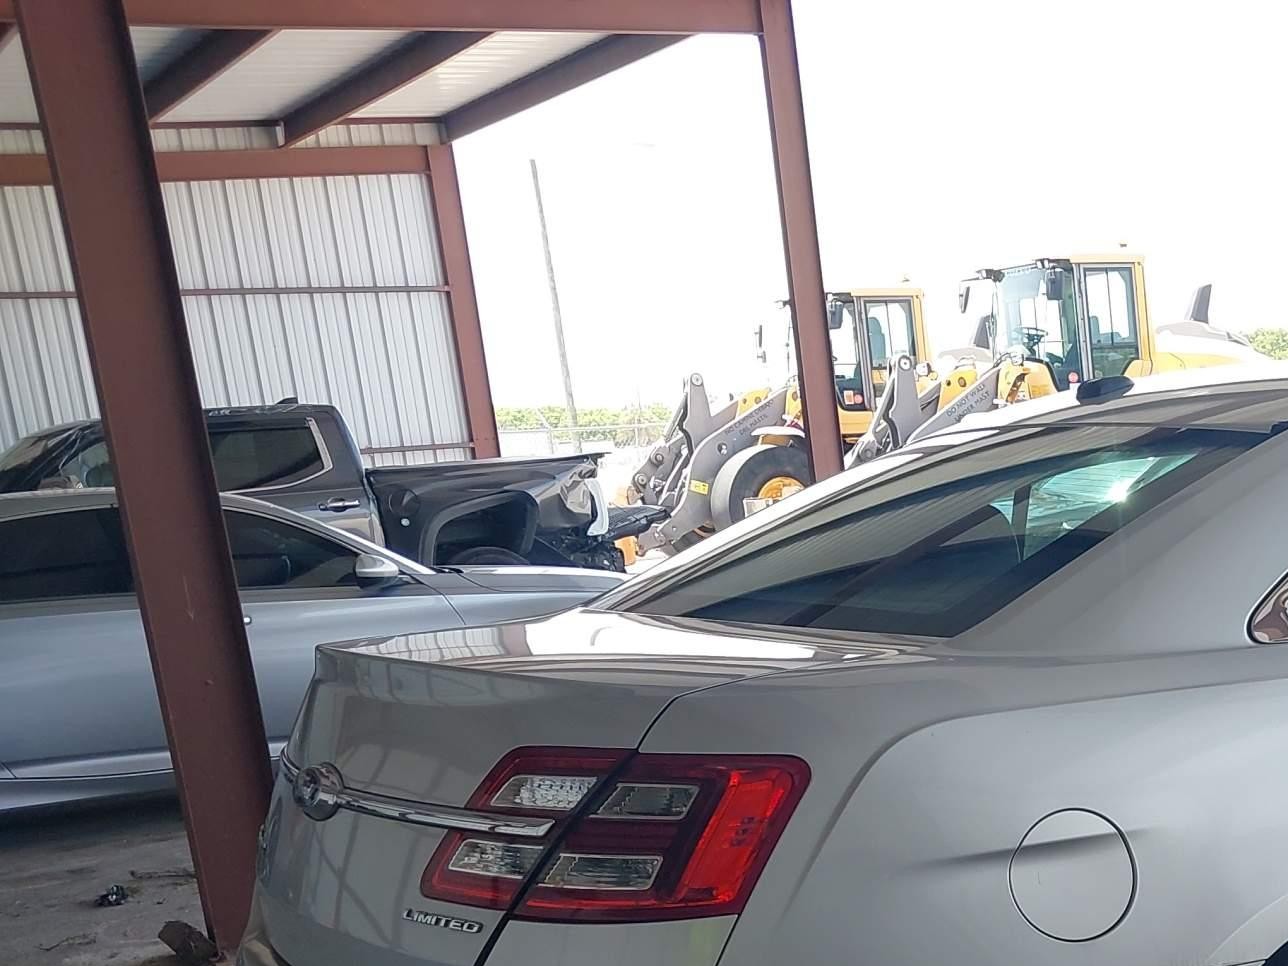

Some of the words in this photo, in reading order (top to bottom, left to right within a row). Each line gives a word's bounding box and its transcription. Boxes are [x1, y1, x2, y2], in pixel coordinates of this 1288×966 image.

[946, 406, 957, 417] DO
[956, 395, 969, 409] NOT
[974, 390, 991, 406] MAST
[402, 908, 483, 933] LIMITED
